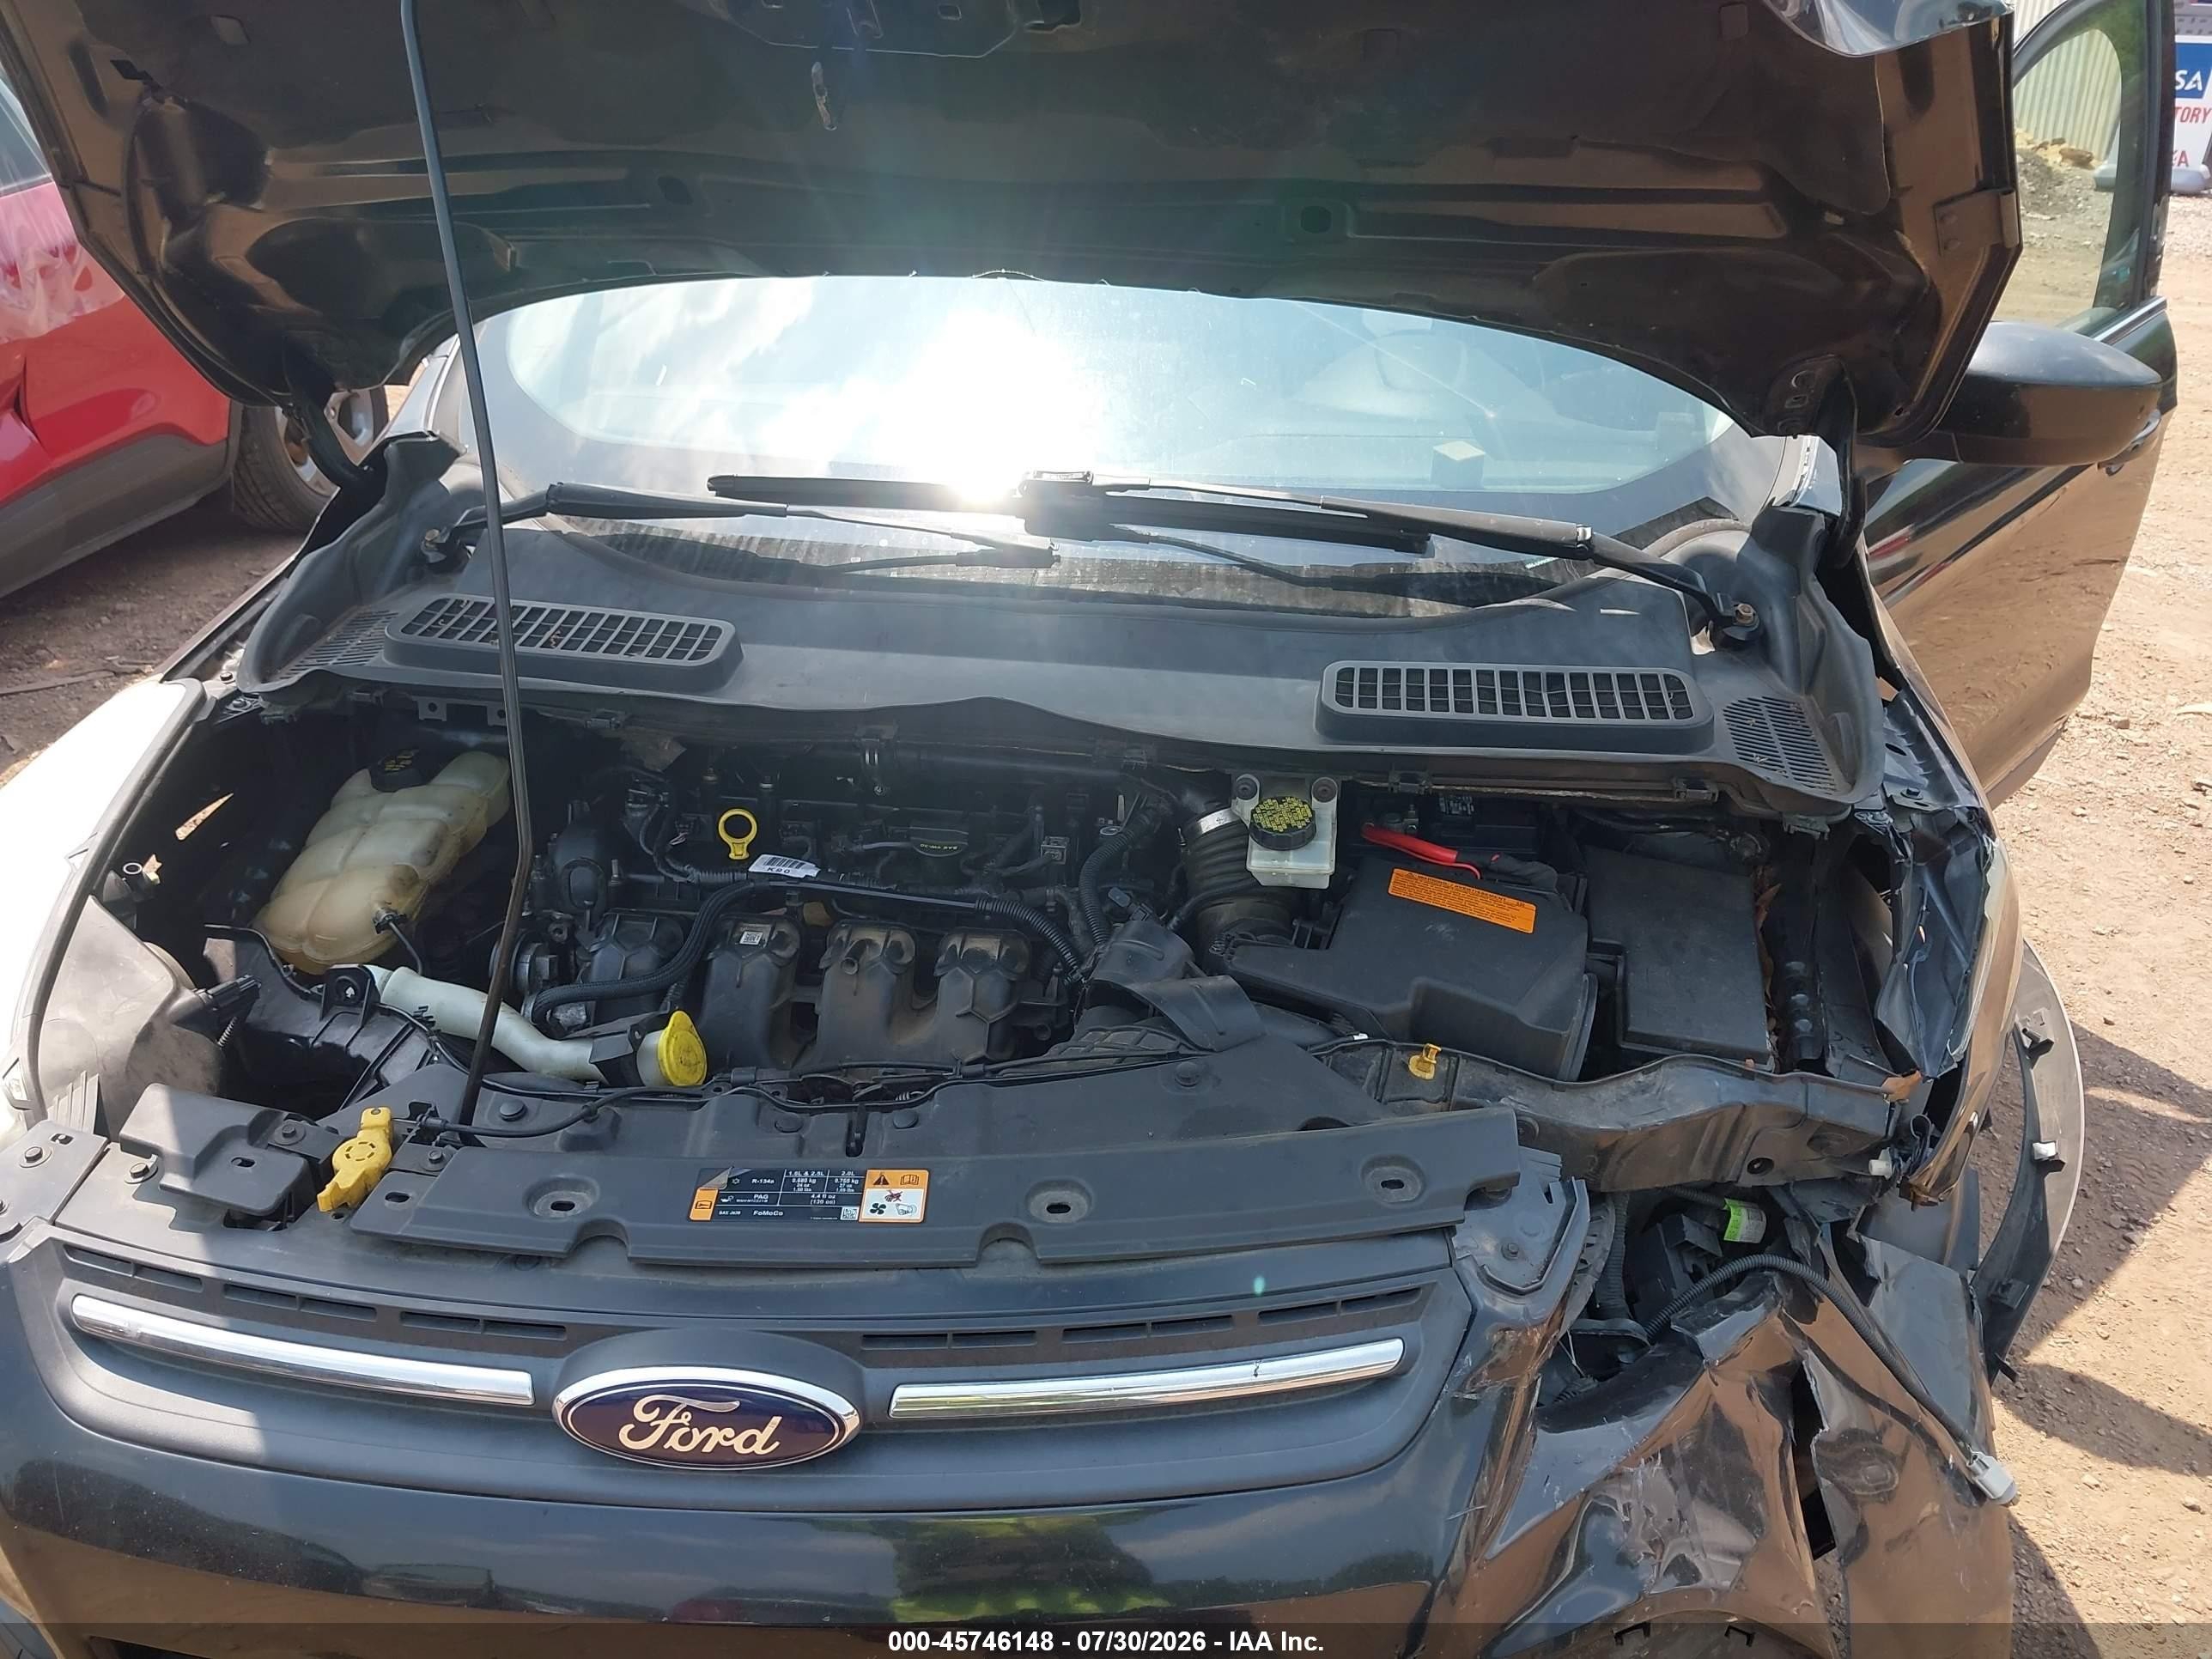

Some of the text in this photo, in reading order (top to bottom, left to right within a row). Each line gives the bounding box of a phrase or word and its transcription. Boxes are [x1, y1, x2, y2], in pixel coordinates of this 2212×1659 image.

[2175, 69, 2203, 91] SA
[2174, 106, 2212, 124] TORY
[618, 1394, 782, 1455] Ford
